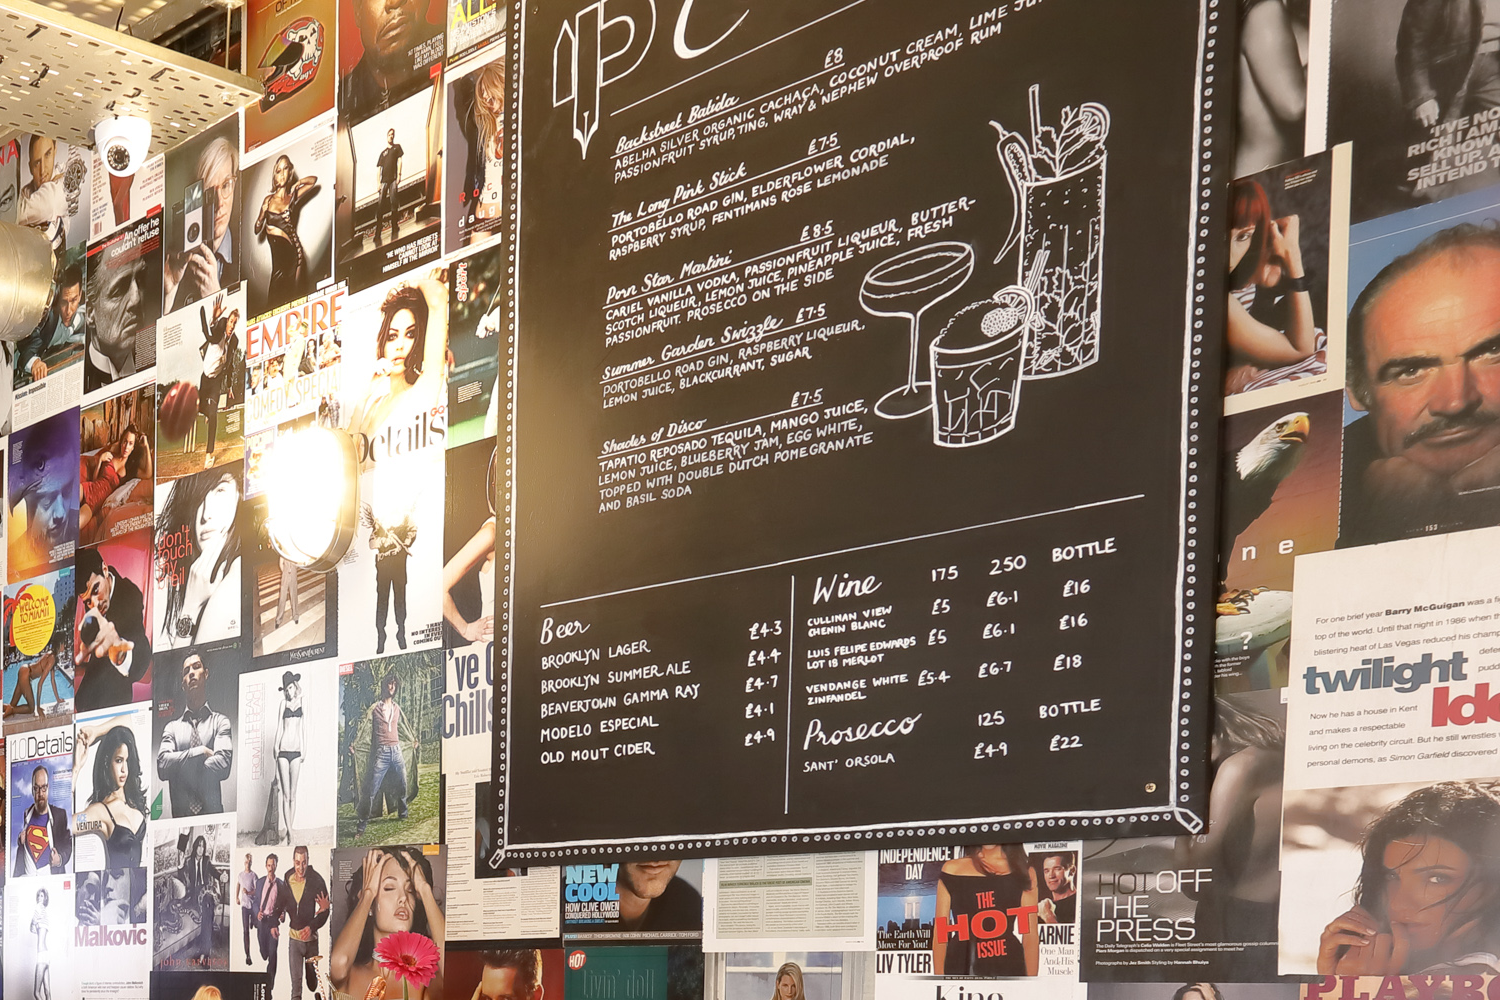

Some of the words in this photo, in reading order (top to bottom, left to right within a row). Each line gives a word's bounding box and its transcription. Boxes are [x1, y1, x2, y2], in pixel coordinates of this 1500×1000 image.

[824, 47, 844, 66] £8
[615, 111, 683, 155] Backstreet
[686, 92, 740, 124] Batida
[1407, 133, 1453, 158] RICH
[1433, 132, 1495, 162] KNOW
[1406, 159, 1451, 181] SELL
[1416, 160, 1488, 191] INTEND
[611, 210, 633, 228] The
[636, 197, 671, 218] Long
[672, 179, 706, 207] Pink
[709, 161, 748, 191] Stick
[605, 284, 638, 305] Porn
[640, 272, 675, 293] Star
[679, 249, 733, 280] Martini
[246, 291, 345, 360] EMPIRE
[601, 356, 656, 381] Summer
[661, 334, 716, 362] Garden
[720, 314, 784, 344] Swizzle
[601, 434, 647, 455] Shades
[650, 426, 665, 442] of
[666, 418, 708, 438] Disco
[598, 499, 621, 514] AND
[626, 492, 657, 509] BASIL
[660, 484, 692, 500] SODA
[931, 565, 959, 582] 175
[988, 554, 1027, 576] 250
[1051, 537, 1117, 563] BOTTLE
[812, 572, 883, 605] Wine
[931, 598, 951, 616] £5
[1062, 579, 1091, 598] £16
[807, 611, 858, 627] CULLINAN
[861, 605, 893, 619] VIEW
[1385, 606, 1412, 617] Barry
[1414, 601, 1465, 615] McGuigan
[1446, 616, 1467, 625] 1986
[539, 617, 591, 645] Beer
[807, 624, 846, 638] CHENIN
[850, 618, 887, 631] BLANC
[541, 647, 600, 670] BROOKLYN
[608, 639, 652, 659] LAGER
[807, 647, 831, 659] LUIS
[833, 642, 868, 657] FELIPE
[869, 635, 917, 652] EDWARDS
[1378, 641, 1393, 649] Las
[1395, 638, 1421, 649] Vegas
[806, 659, 826, 670] LOT
[827, 657, 839, 668] 18
[842, 653, 885, 667] MERLOT
[1053, 653, 1082, 672] £18
[1302, 651, 1469, 695] twilight
[540, 673, 600, 695] BROOKLYN
[607, 664, 665, 684] SUMMER
[665, 660, 692, 676] ALE
[540, 696, 617, 719] BEAVERTOWN
[623, 688, 669, 706] GAMMA
[674, 683, 701, 700] RAY
[978, 710, 1006, 727] 125
[1038, 698, 1102, 719] BOTTLE
[540, 723, 592, 743] MODELO
[599, 715, 660, 733] ESPECIAL
[802, 713, 923, 751] Prosecco
[27, 731, 73, 759] Details
[540, 750, 565, 765] OLD
[571, 747, 610, 762] MOUT
[613, 741, 656, 757] CIDER
[1049, 734, 1084, 752] £22
[802, 758, 839, 773] SANT'
[845, 752, 896, 768] ORSOLA
[1389, 753, 1415, 762] Simon
[1417, 751, 1450, 760] Garfield
[76, 817, 102, 831] VENTURA
[879, 846, 951, 864] INDEPENDENCE
[566, 864, 619, 883] NEW
[905, 864, 924, 880] DAY
[1098, 872, 1153, 897] HOT
[1155, 868, 1212, 894] OFF
[565, 883, 619, 902] COOL
[976, 891, 995, 909] THE
[565, 902, 581, 913] HOW
[582, 901, 599, 912] CLIVE
[600, 901, 619, 911] OWEN
[1095, 895, 1149, 919] THE
[935, 905, 1038, 944] HOT
[1039, 925, 1075, 945] ARNIE
[1096, 918, 1196, 942] PRESS
[977, 939, 1007, 958] ISSUE
[876, 954, 894, 974] LIV
[898, 953, 931, 974] TYLER
